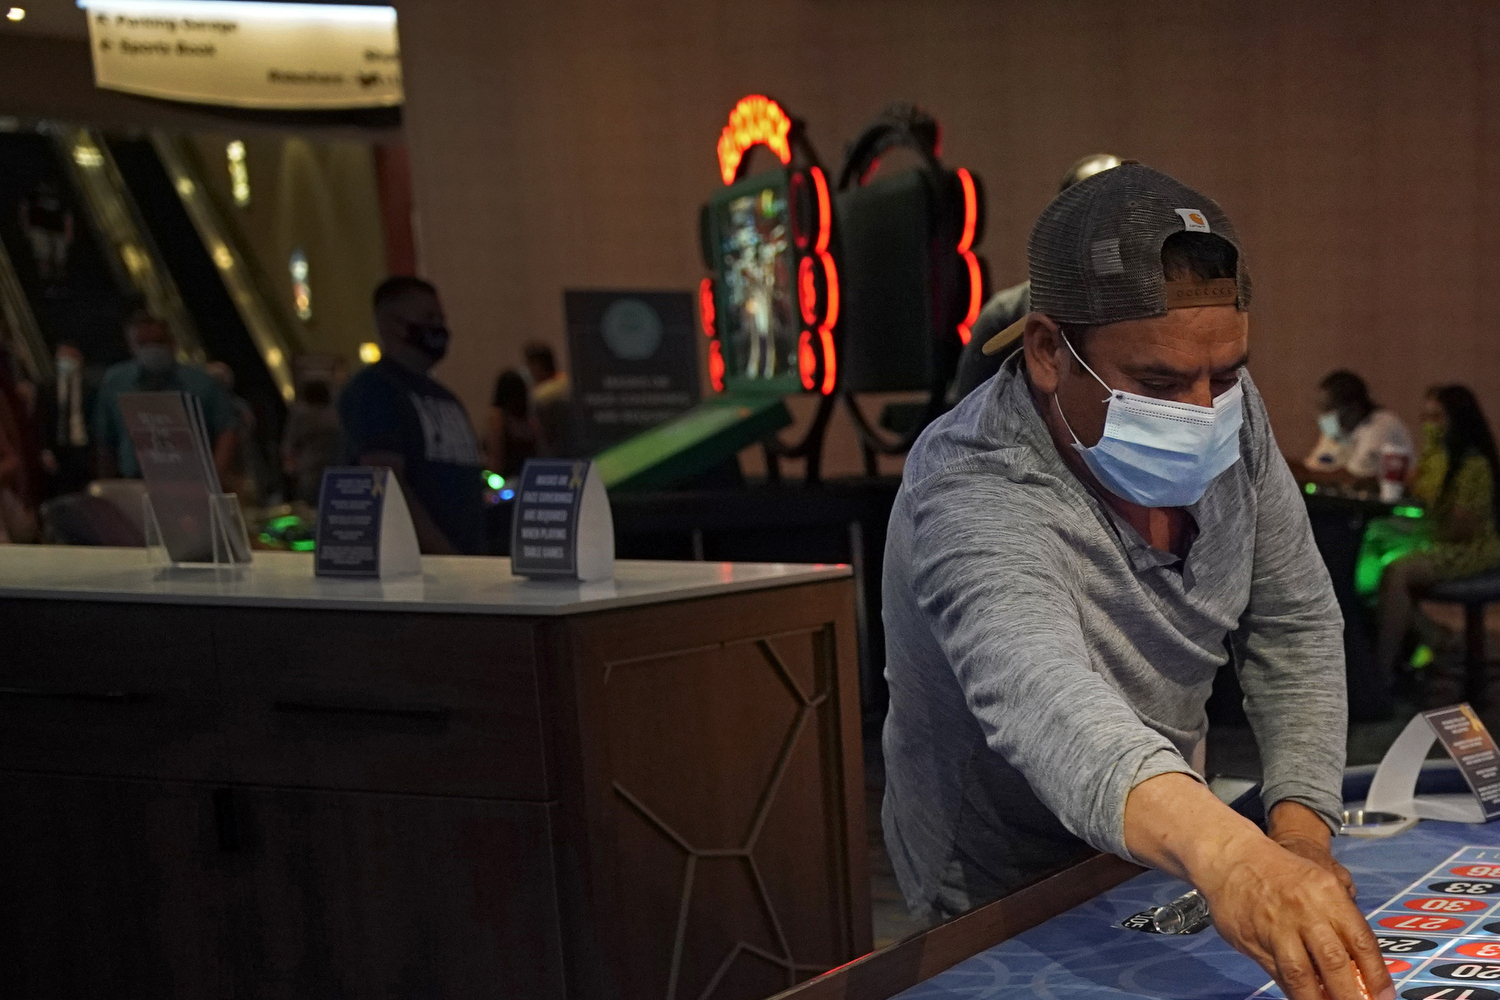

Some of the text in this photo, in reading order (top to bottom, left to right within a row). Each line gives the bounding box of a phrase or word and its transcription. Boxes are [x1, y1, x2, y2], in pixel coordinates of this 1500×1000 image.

[1443, 881, 1494, 895] 33
[1420, 897, 1471, 912] 30
[1393, 916, 1451, 930] 27
